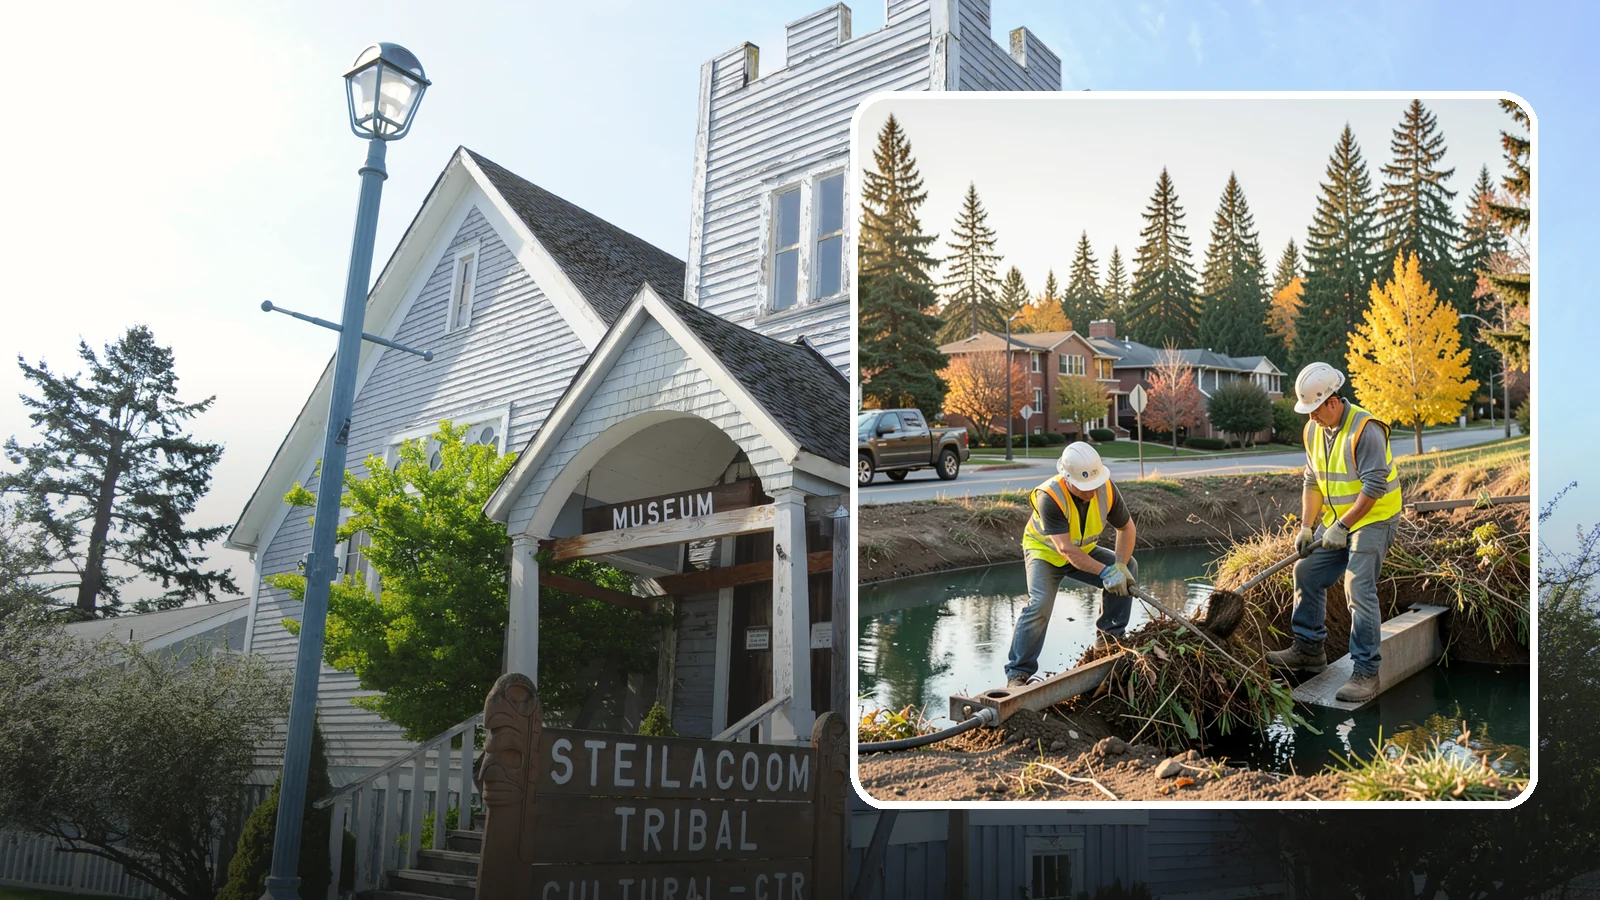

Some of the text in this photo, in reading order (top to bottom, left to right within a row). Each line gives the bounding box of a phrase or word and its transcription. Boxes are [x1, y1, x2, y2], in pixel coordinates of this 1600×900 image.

[612, 491, 714, 531] MUSEUM
[550, 738, 810, 793] STEILACOOM
[614, 806, 758, 852] TRIBAL
